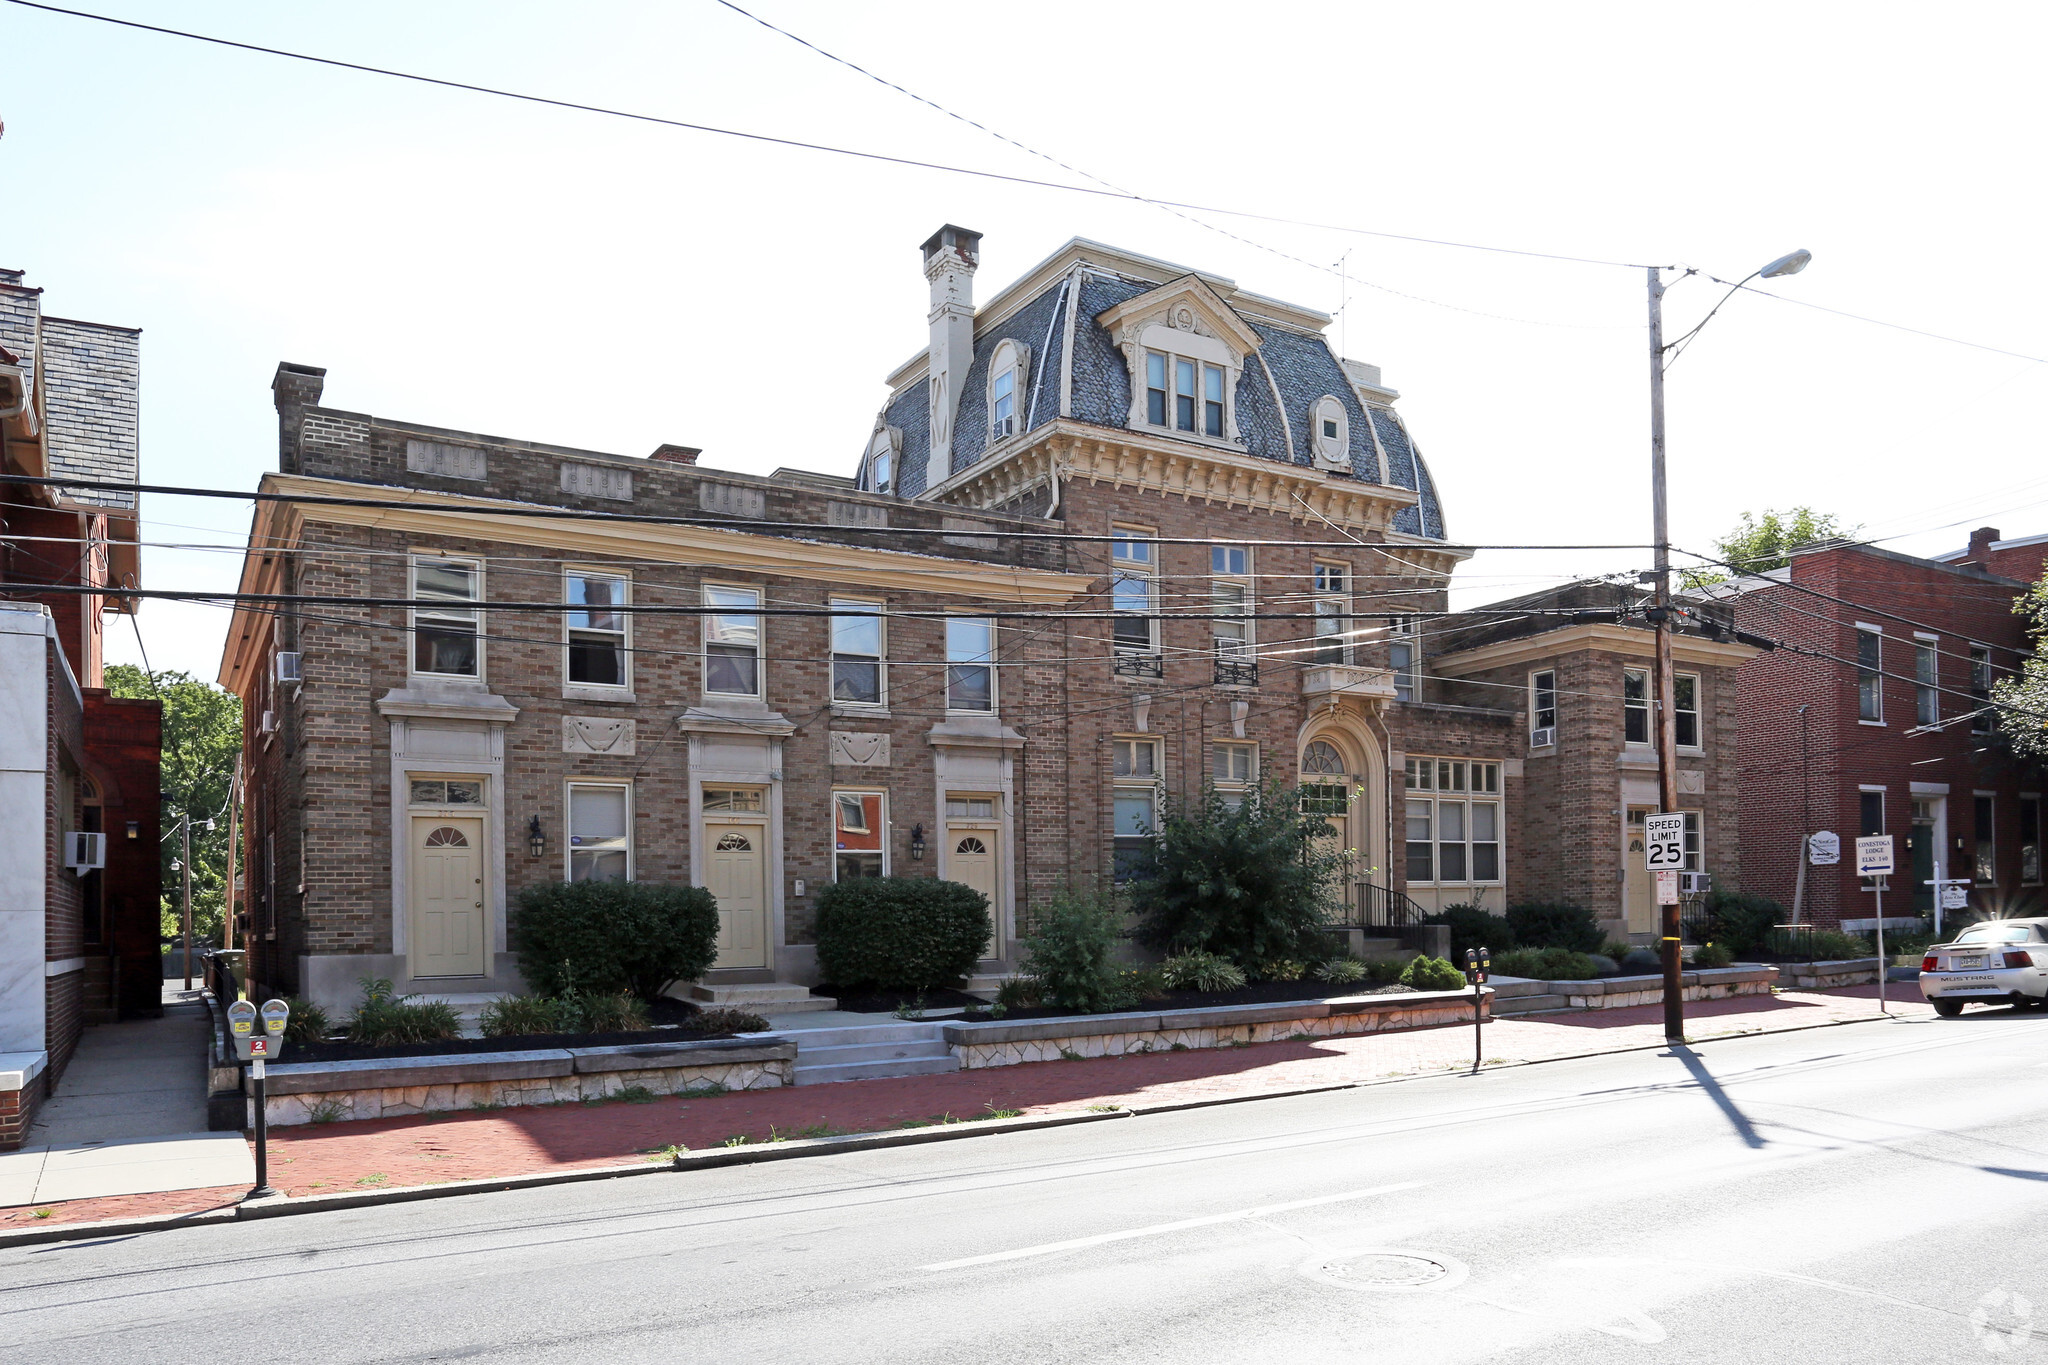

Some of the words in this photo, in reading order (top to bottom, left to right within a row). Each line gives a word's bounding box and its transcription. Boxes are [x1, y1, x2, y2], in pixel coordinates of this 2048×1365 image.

[1648, 820, 1681, 830] SPEED
[1652, 831, 1677, 841] LIMIT
[1858, 840, 1890, 848] CONESTOGA
[1649, 843, 1681, 864] 25
[255, 1041, 263, 1049] 2
